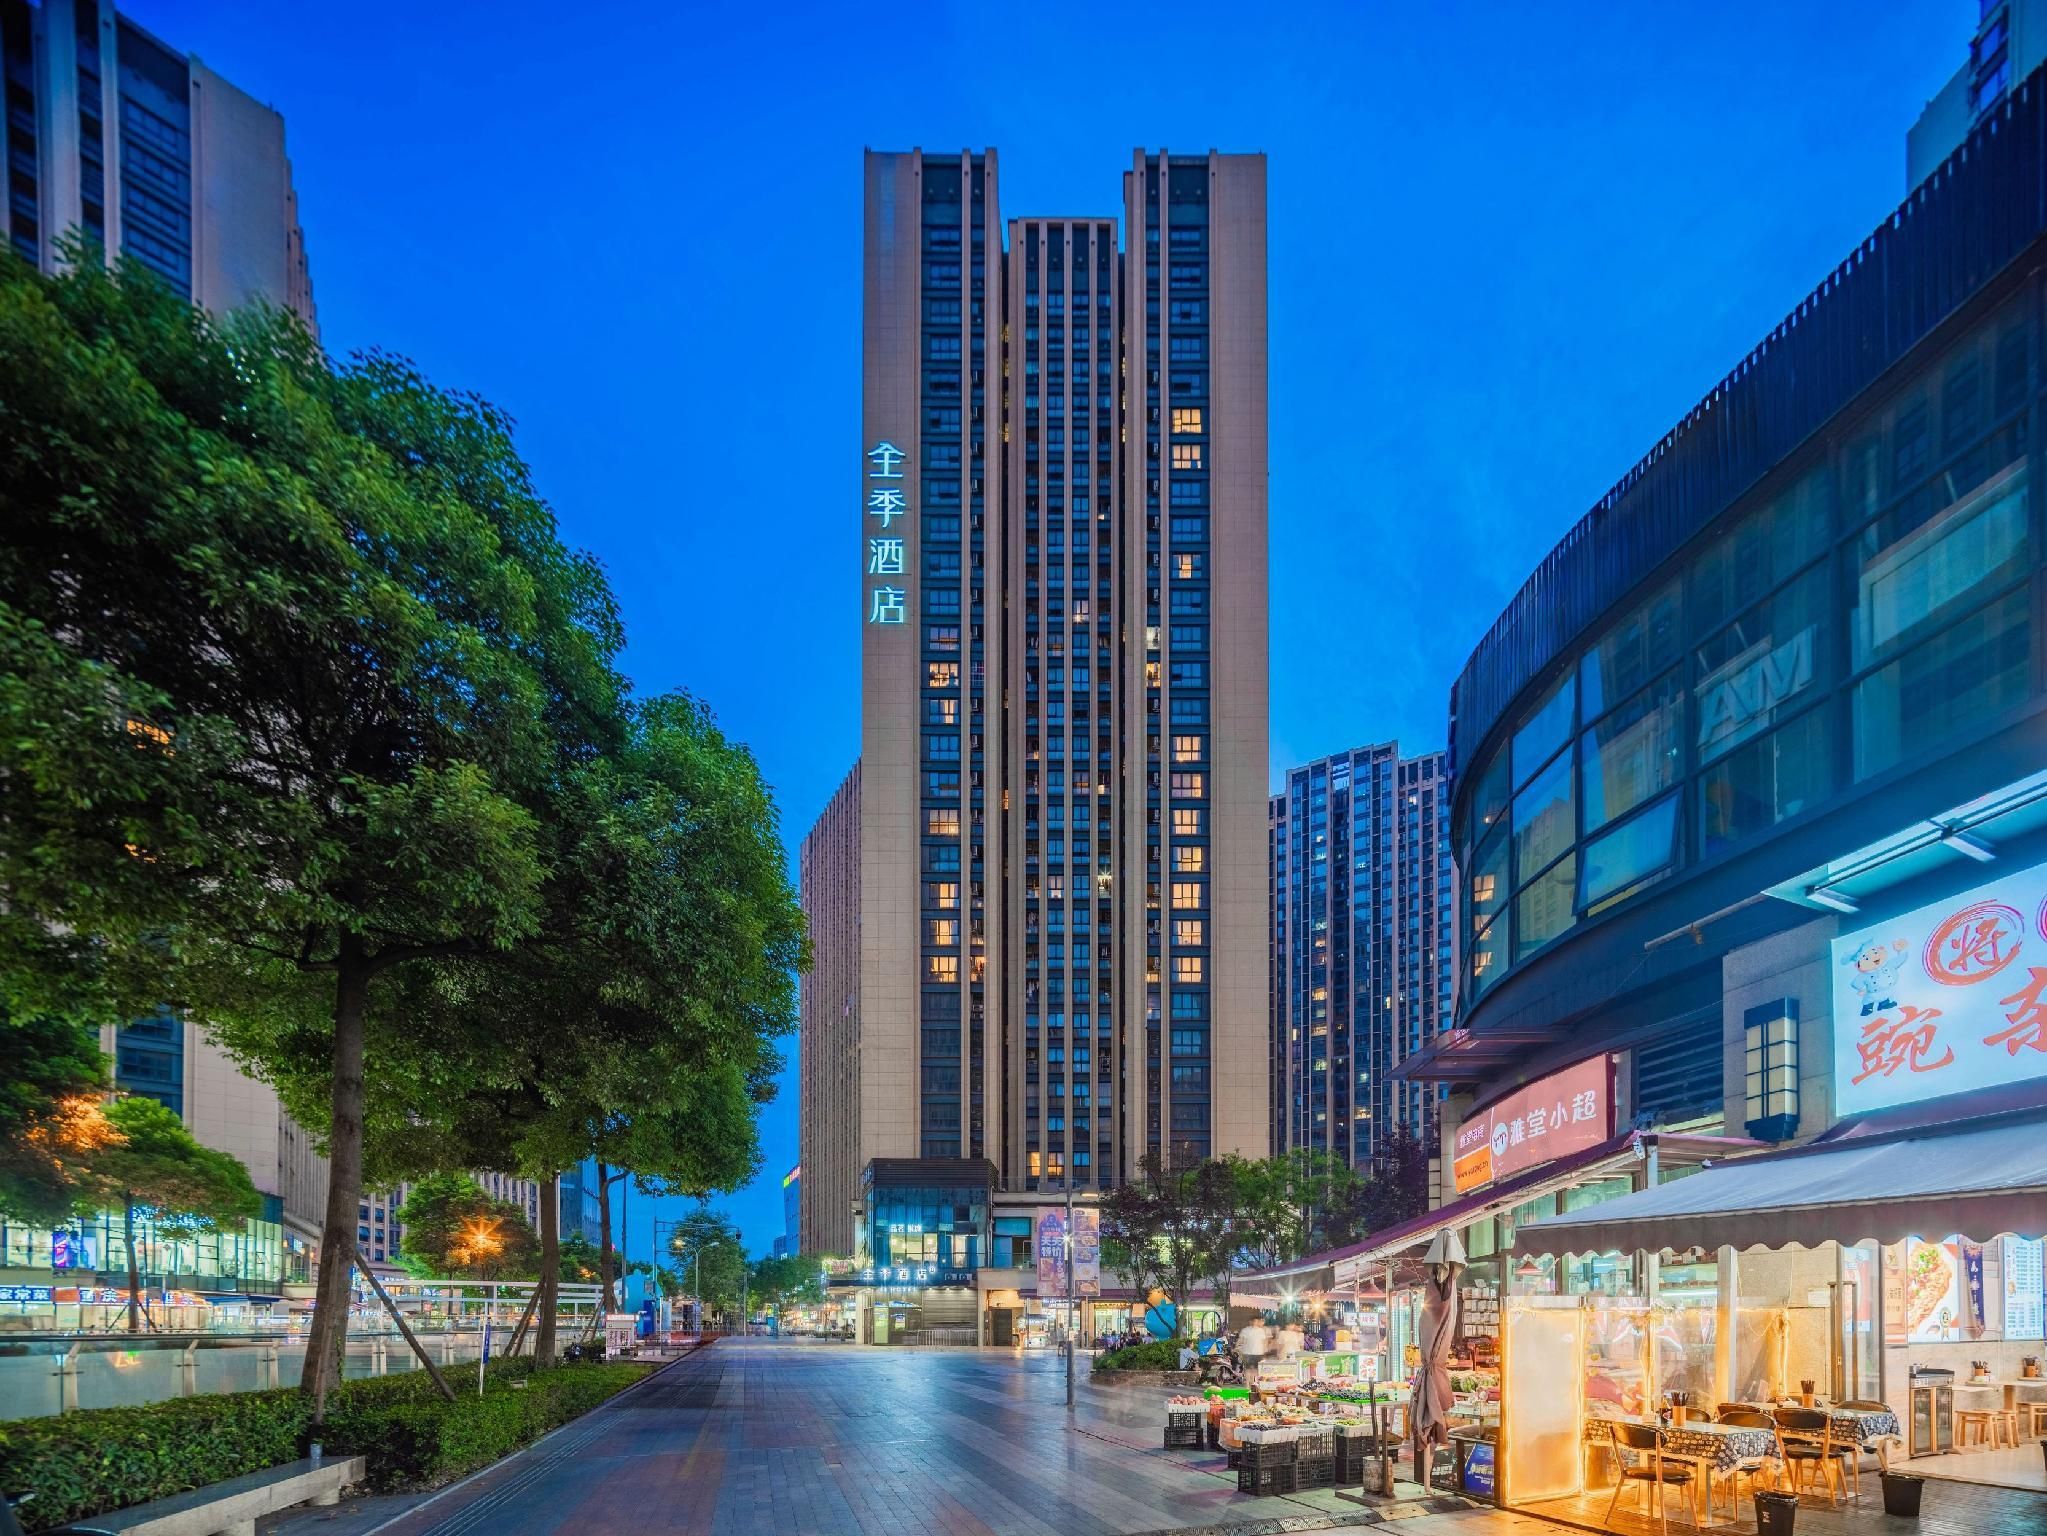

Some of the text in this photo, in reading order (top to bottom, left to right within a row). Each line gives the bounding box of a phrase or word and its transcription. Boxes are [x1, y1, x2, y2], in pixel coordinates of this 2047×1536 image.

[867, 441, 906, 624] 全季酒店
[1948, 917, 2008, 972] 将
[1509, 1090, 1597, 1147] 雅堂小超
